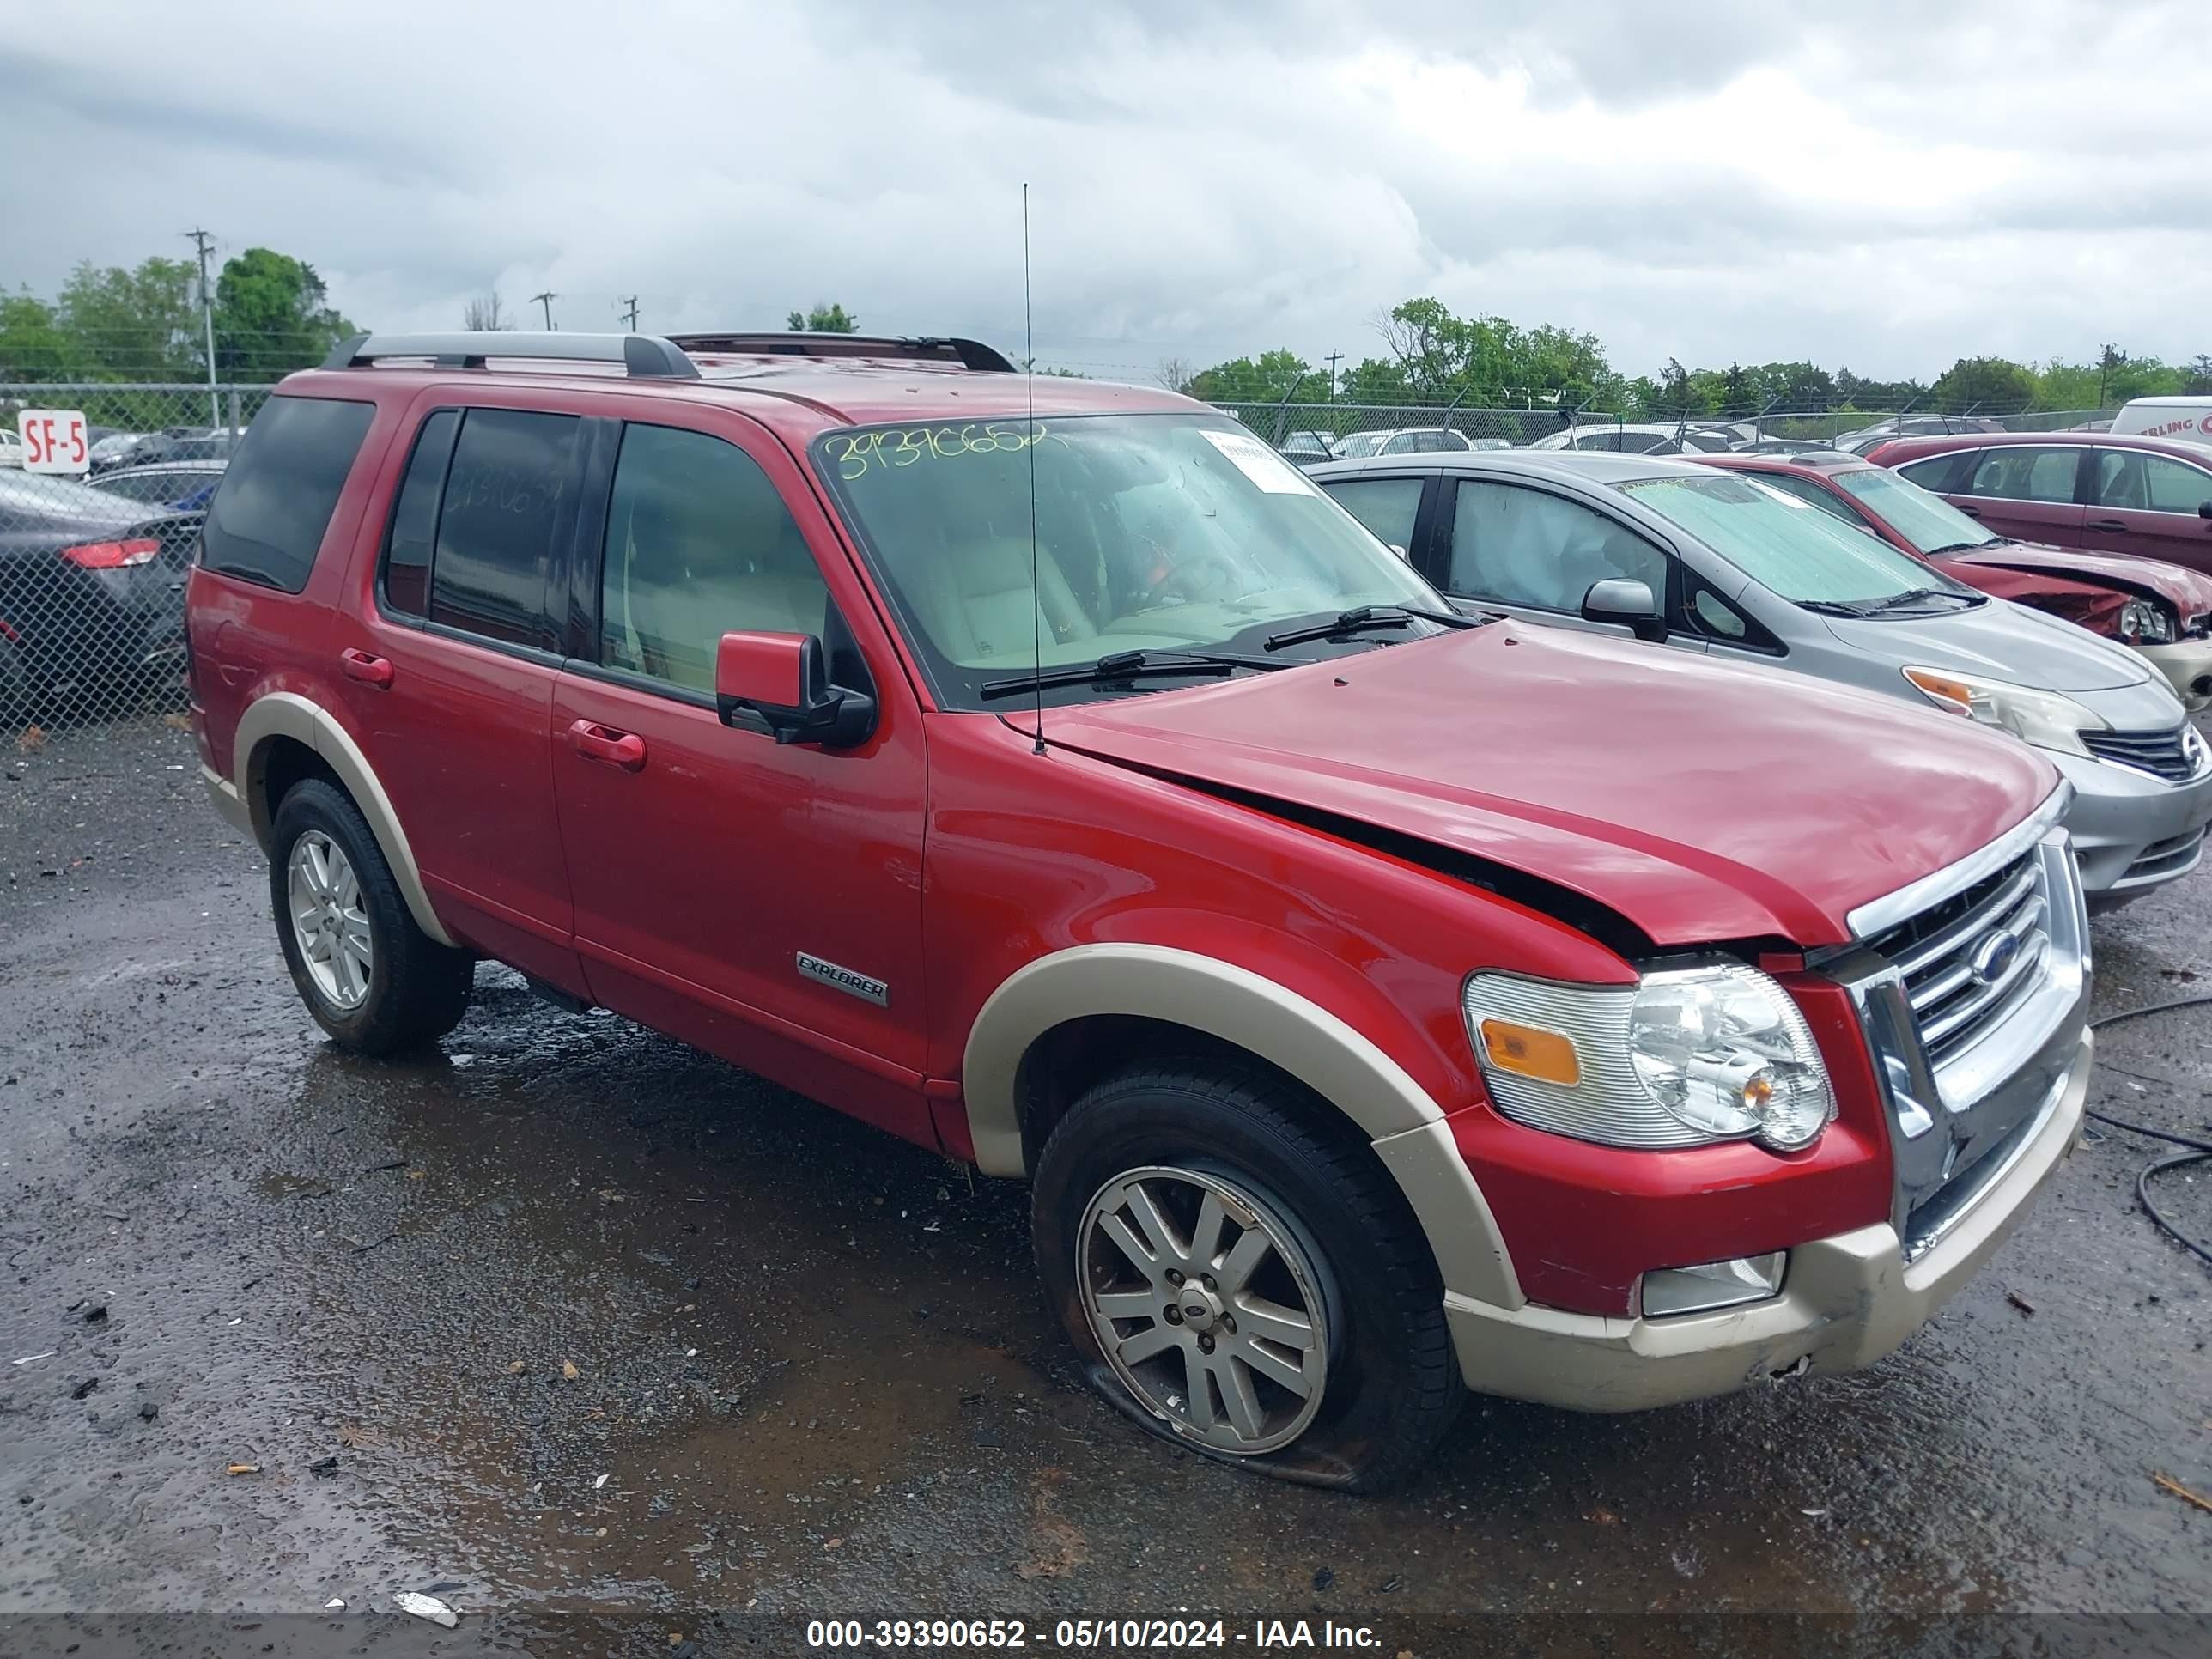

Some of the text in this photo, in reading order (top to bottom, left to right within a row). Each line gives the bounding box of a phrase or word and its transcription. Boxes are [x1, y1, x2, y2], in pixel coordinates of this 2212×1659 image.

[26, 419, 85, 463] SF-5
[2136, 419, 2193, 437] ERLING
[825, 424, 1069, 480] 39390652
[799, 957, 884, 996] EXPLORER
